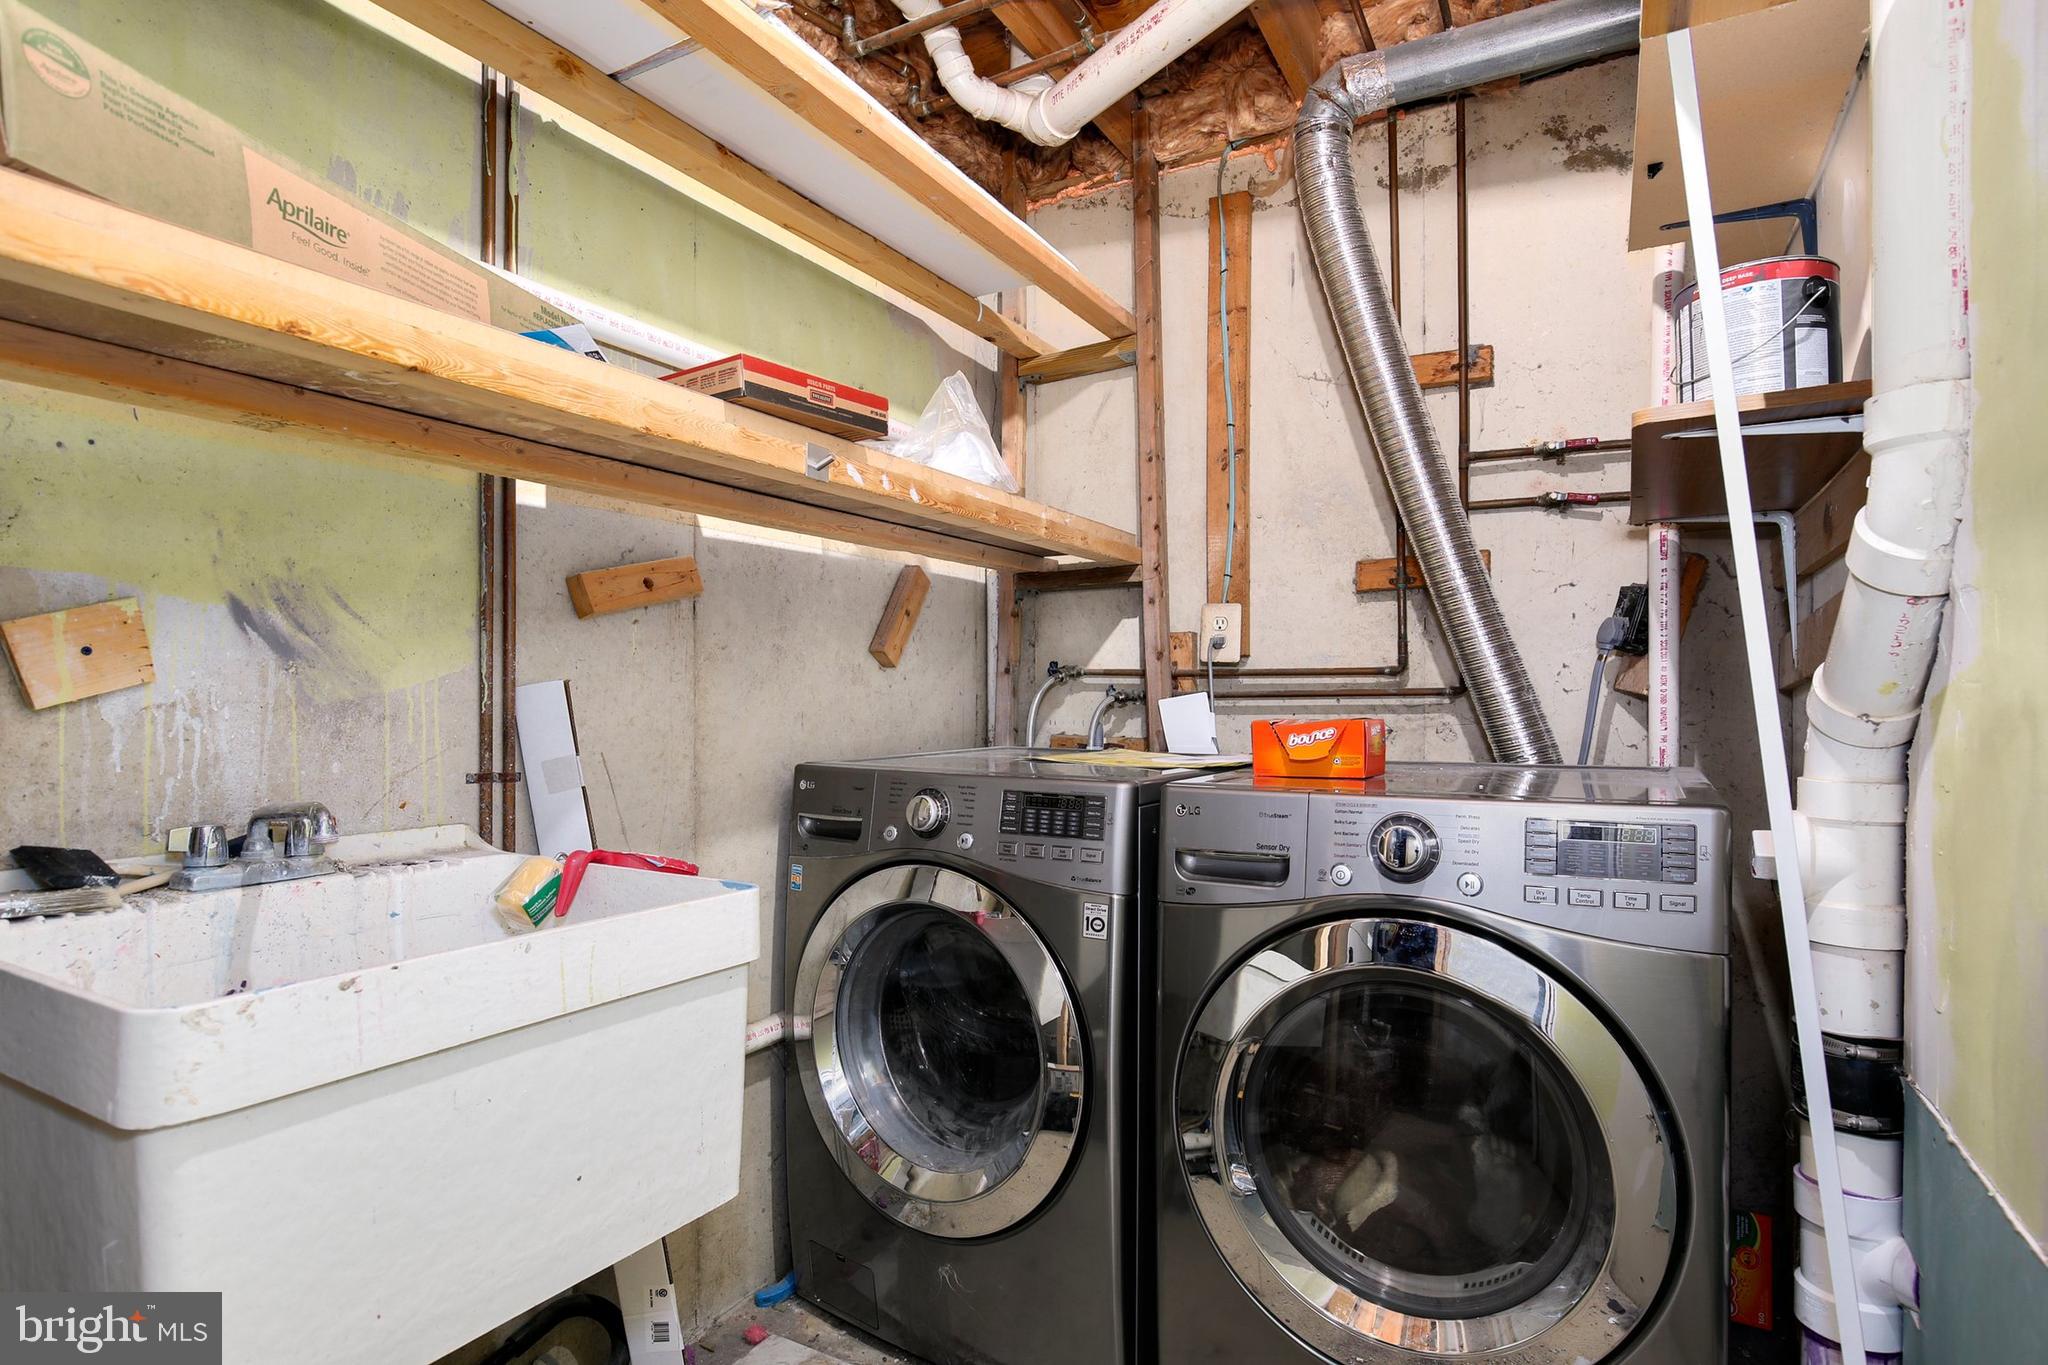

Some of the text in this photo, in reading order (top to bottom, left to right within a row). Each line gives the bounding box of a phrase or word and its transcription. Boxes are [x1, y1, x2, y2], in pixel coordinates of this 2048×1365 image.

[266, 187, 349, 245] Aprilaire
[291, 231, 312, 248] Feel
[1722, 270, 1754, 284] DEEP BASE
[1288, 728, 1336, 747] bounce
[1188, 806, 1201, 815] LG
[1256, 842, 1290, 853] Sensor Dry
[1669, 900, 1687, 908] Signal
[1085, 916, 1105, 933] 10
